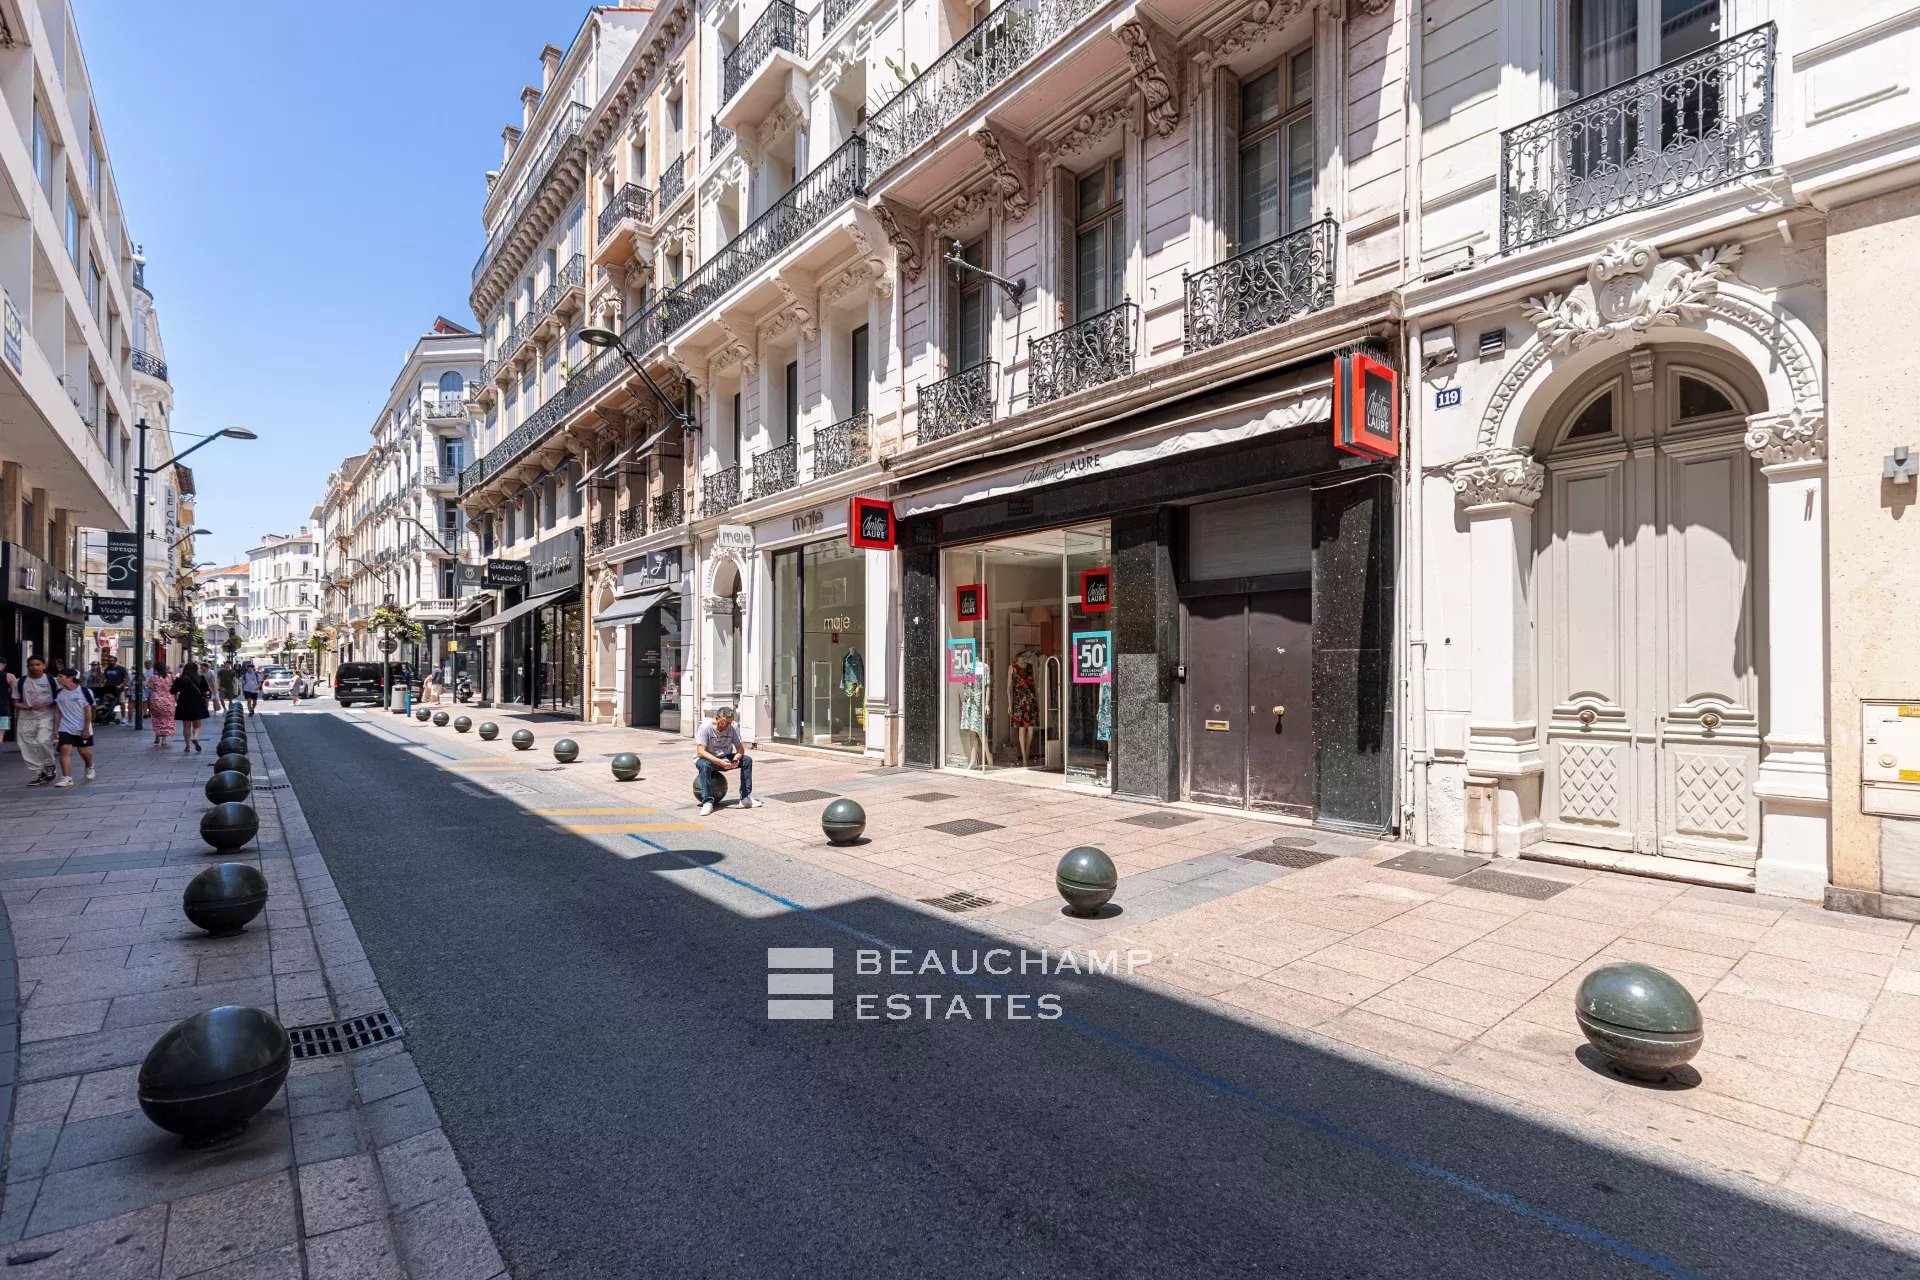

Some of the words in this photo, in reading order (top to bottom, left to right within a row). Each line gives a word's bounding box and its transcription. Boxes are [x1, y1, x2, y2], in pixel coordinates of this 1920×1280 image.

[1438, 391, 1459, 406] 119
[1367, 414, 1389, 434] LAURE
[1022, 462, 1064, 485] Christine
[1063, 454, 1100, 474] LAURE
[167, 489, 174, 506] LE
[792, 509, 824, 533] maje
[722, 532, 751, 545] maje
[862, 530, 885, 539] LAURE
[489, 562, 523, 571] Galerie
[491, 573, 523, 582] Vieceli
[823, 613, 850, 632] maje
